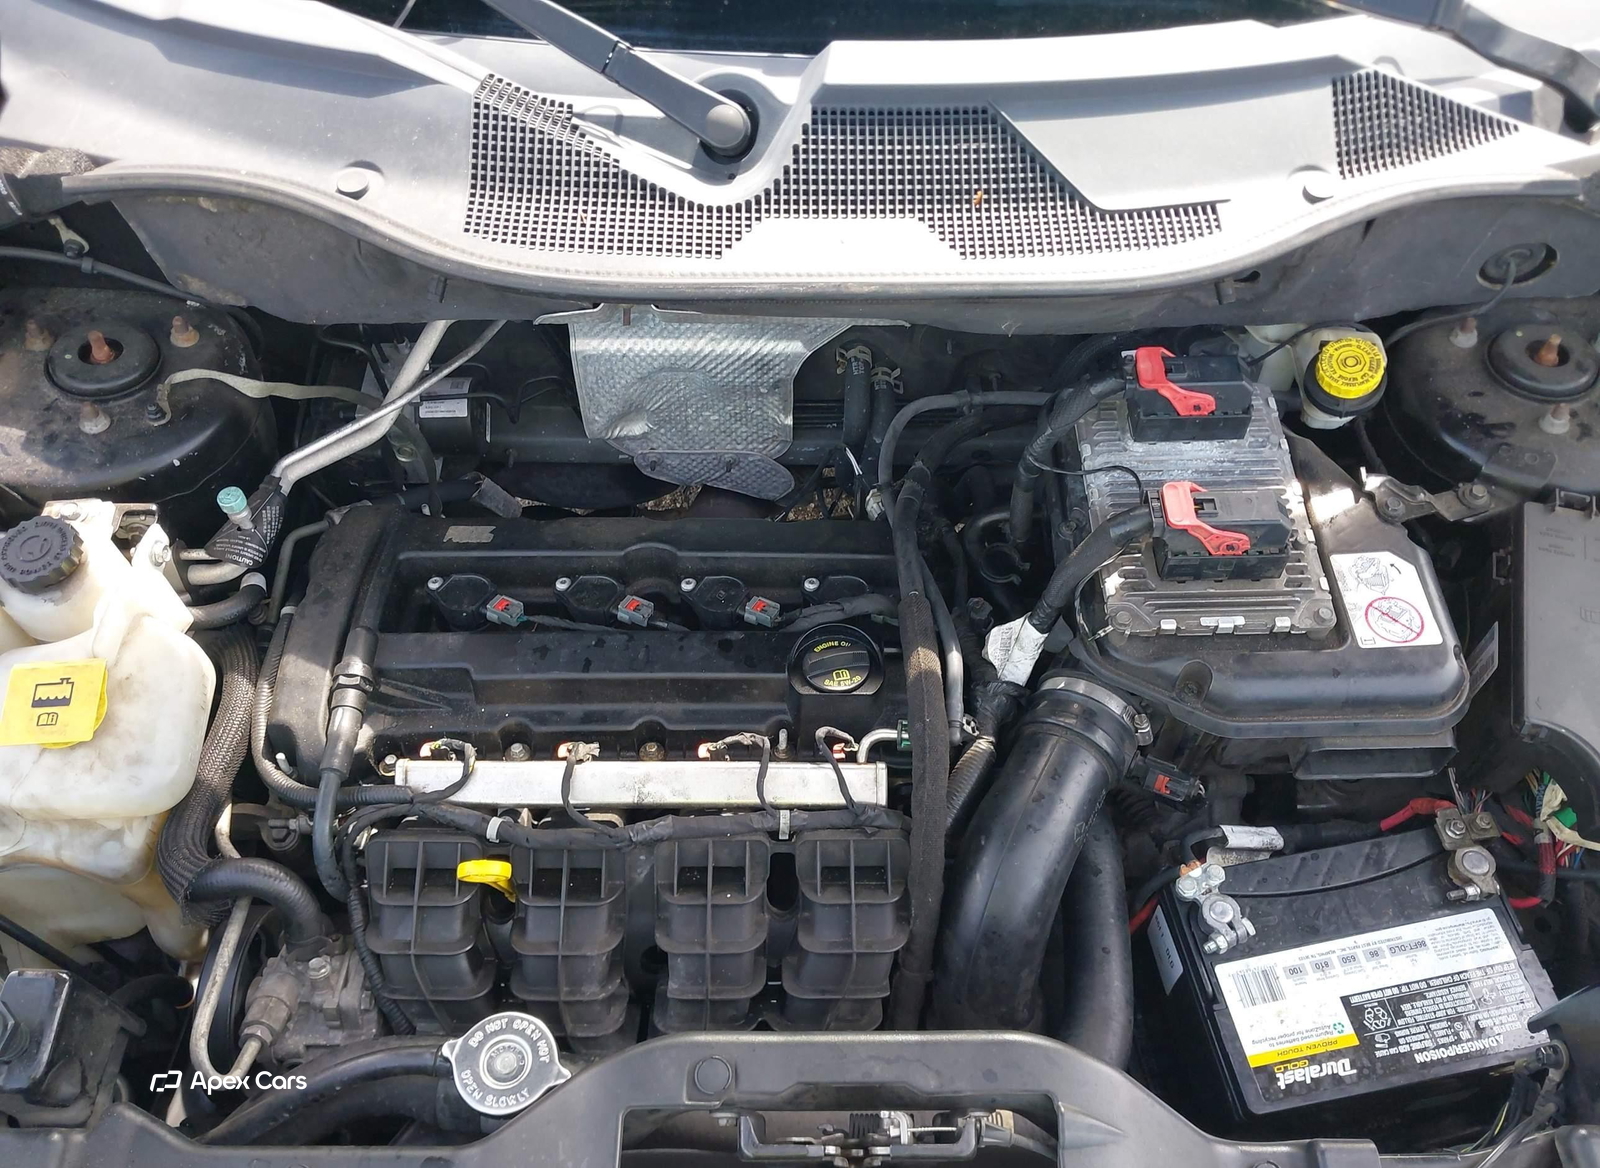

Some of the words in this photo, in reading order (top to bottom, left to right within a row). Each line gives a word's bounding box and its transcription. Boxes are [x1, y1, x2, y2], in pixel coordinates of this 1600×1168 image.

[814, 641, 839, 653] ENGINE
[824, 679, 838, 687] SAE
[841, 675, 862, 687] 5W-20
[1388, 939, 1427, 954] 86FT-DLG
[1367, 949, 1380, 958] 86
[1340, 954, 1356, 964] 650
[1313, 960, 1330, 969] 810
[1287, 966, 1302, 975] 100
[1275, 1030, 1295, 1039] proper
[1299, 1033, 1314, 1041] used
[1314, 1029, 1334, 1038] Return
[1458, 1029, 1471, 1039] NO
[468, 1030, 484, 1048] DO
[485, 1018, 509, 1033] NOT
[512, 1019, 542, 1040] OPEN
[536, 1038, 550, 1064] HOT
[1250, 1035, 1276, 1045] recycling
[1274, 1036, 1300, 1046] batteries
[1304, 1038, 1338, 1050] PROVEN
[1275, 1046, 1303, 1056] TOUGH
[1412, 1035, 1498, 1063] DANGER/POISON
[1272, 1058, 1309, 1073] GOLD
[1273, 1056, 1358, 1090] Duralast
[460, 1069, 483, 1100] OPEN
[484, 1087, 530, 1108] SLOWLY
